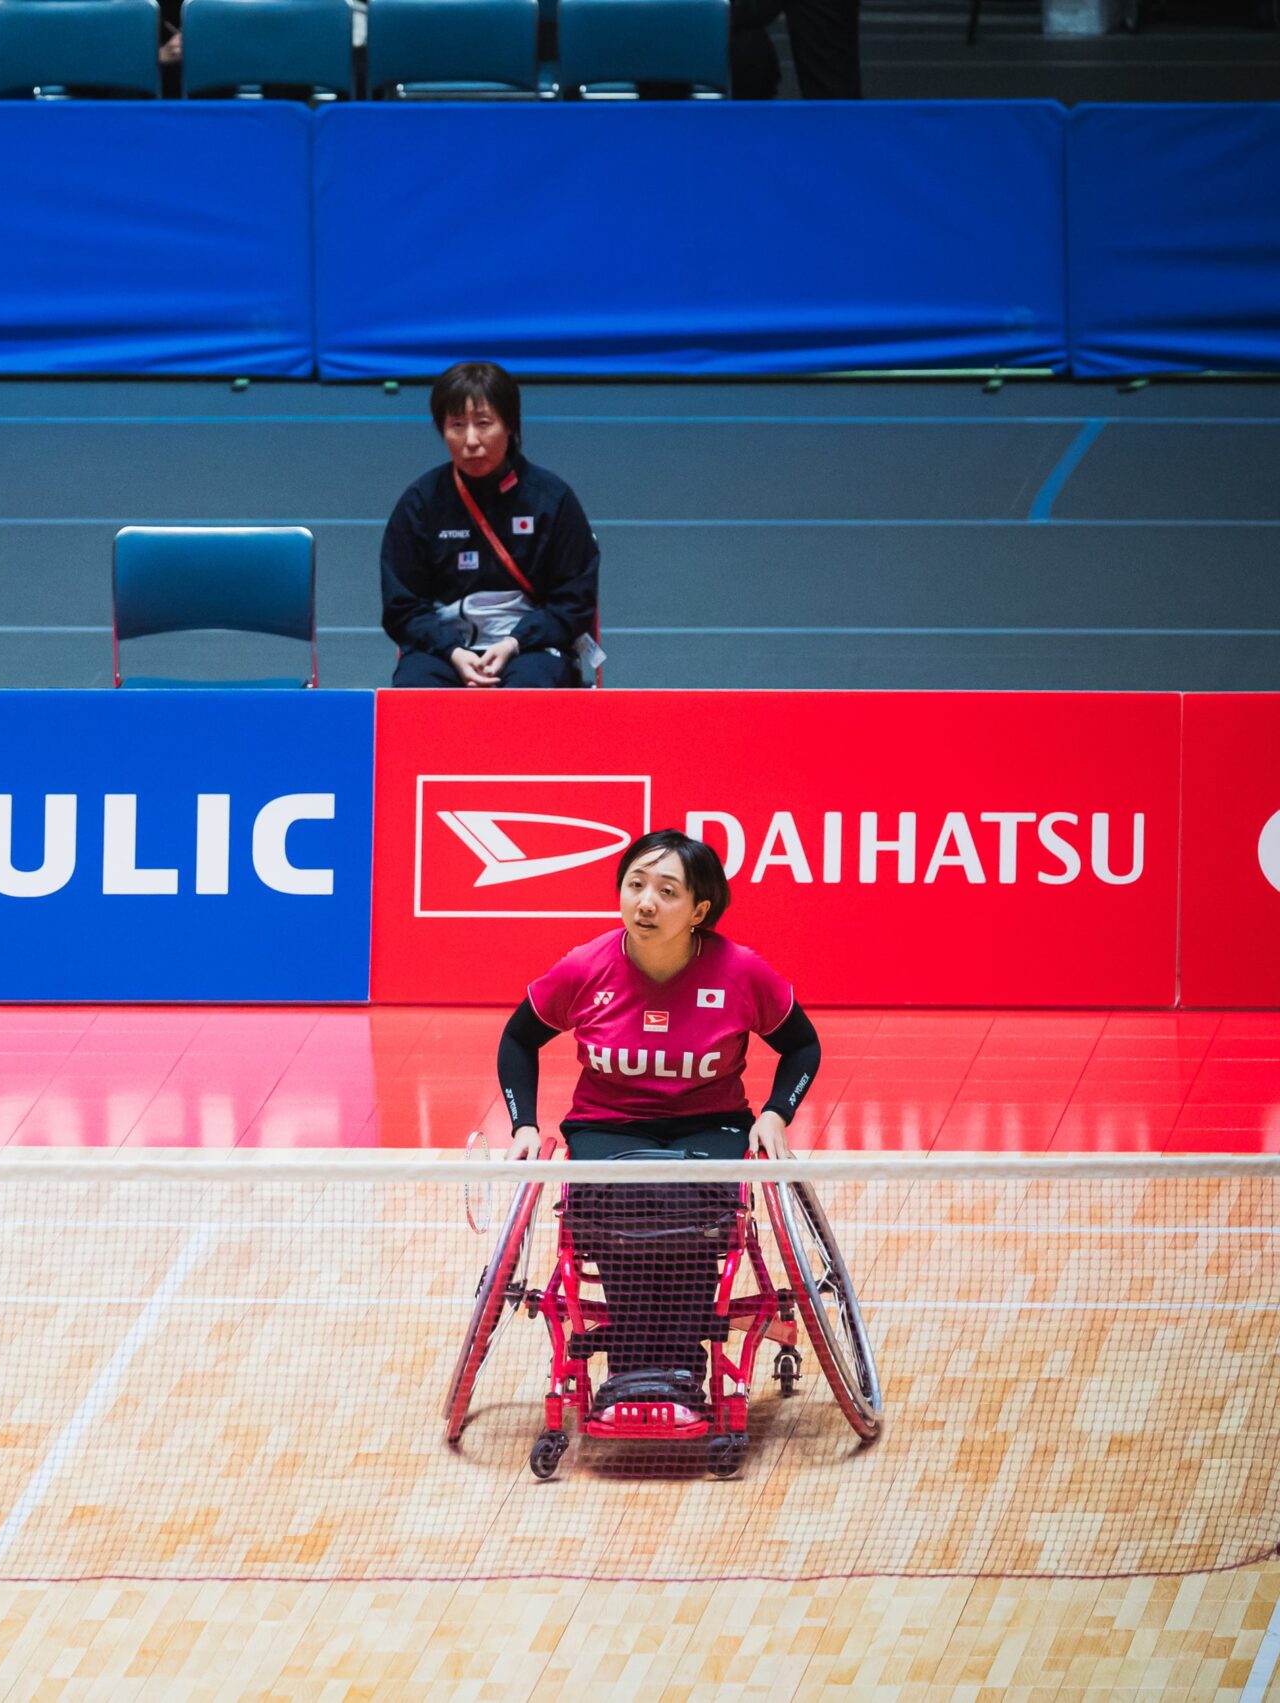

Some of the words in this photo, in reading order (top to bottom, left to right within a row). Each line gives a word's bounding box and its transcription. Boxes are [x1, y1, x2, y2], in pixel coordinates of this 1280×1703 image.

[685, 810, 1145, 885] DAIHATSU
[587, 1044, 721, 1079] HULIC
[794, 1072, 810, 1095] YONEX
[509, 1098, 519, 1121] YONEX
